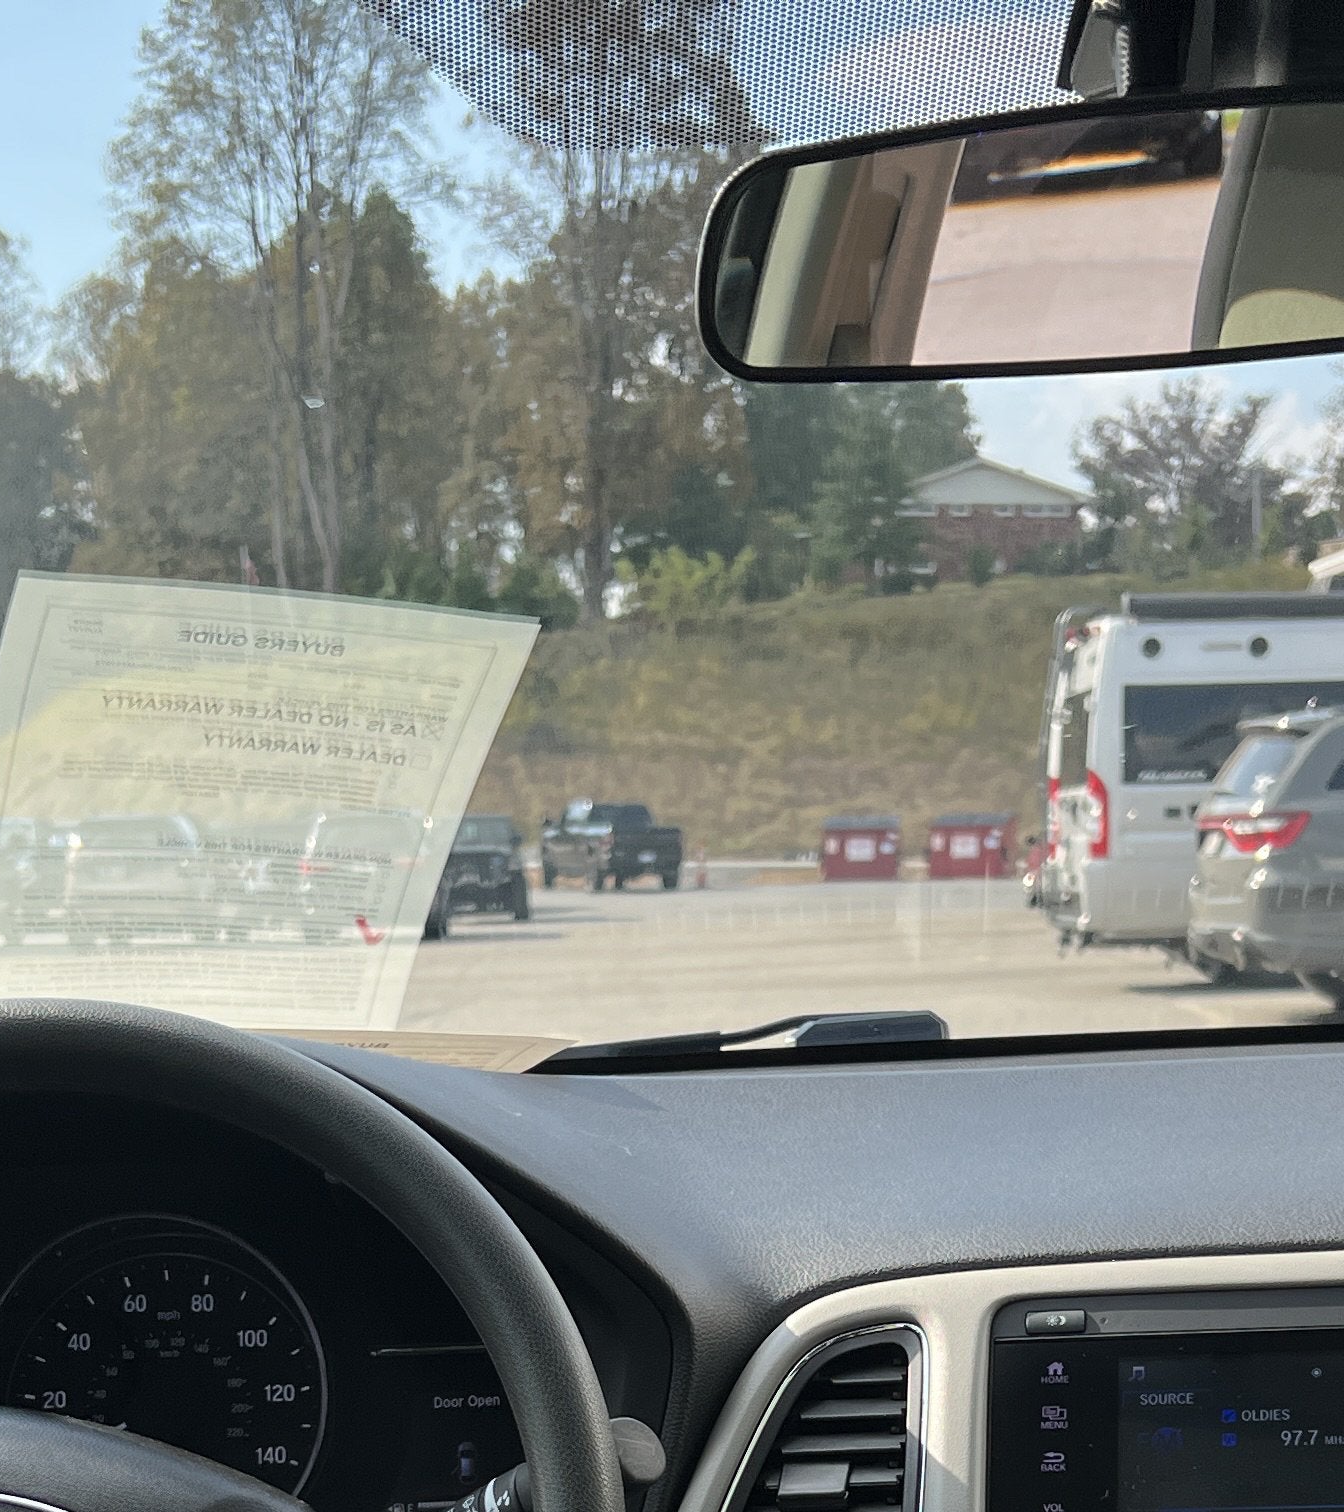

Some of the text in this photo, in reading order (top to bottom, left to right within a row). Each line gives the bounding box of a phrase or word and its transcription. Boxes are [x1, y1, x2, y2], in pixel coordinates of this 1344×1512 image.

[124, 1294, 147, 1312] 60
[191, 1294, 214, 1312] 80
[67, 1333, 91, 1351] 40
[237, 1329, 268, 1347] 100
[1041, 1375, 1069, 1384] HOME
[43, 1391, 66, 1408] 20
[264, 1384, 295, 1401] 120
[1140, 1393, 1194, 1406] SOURCE
[434, 1395, 500, 1409] Door Open
[1241, 1409, 1290, 1422] OLDIES
[1040, 1421, 1068, 1430] MENU
[1281, 1430, 1318, 1446] 97.7
[256, 1446, 286, 1465] 140
[1041, 1464, 1066, 1473] BACK
[1043, 1503, 1064, 1512] VOL
